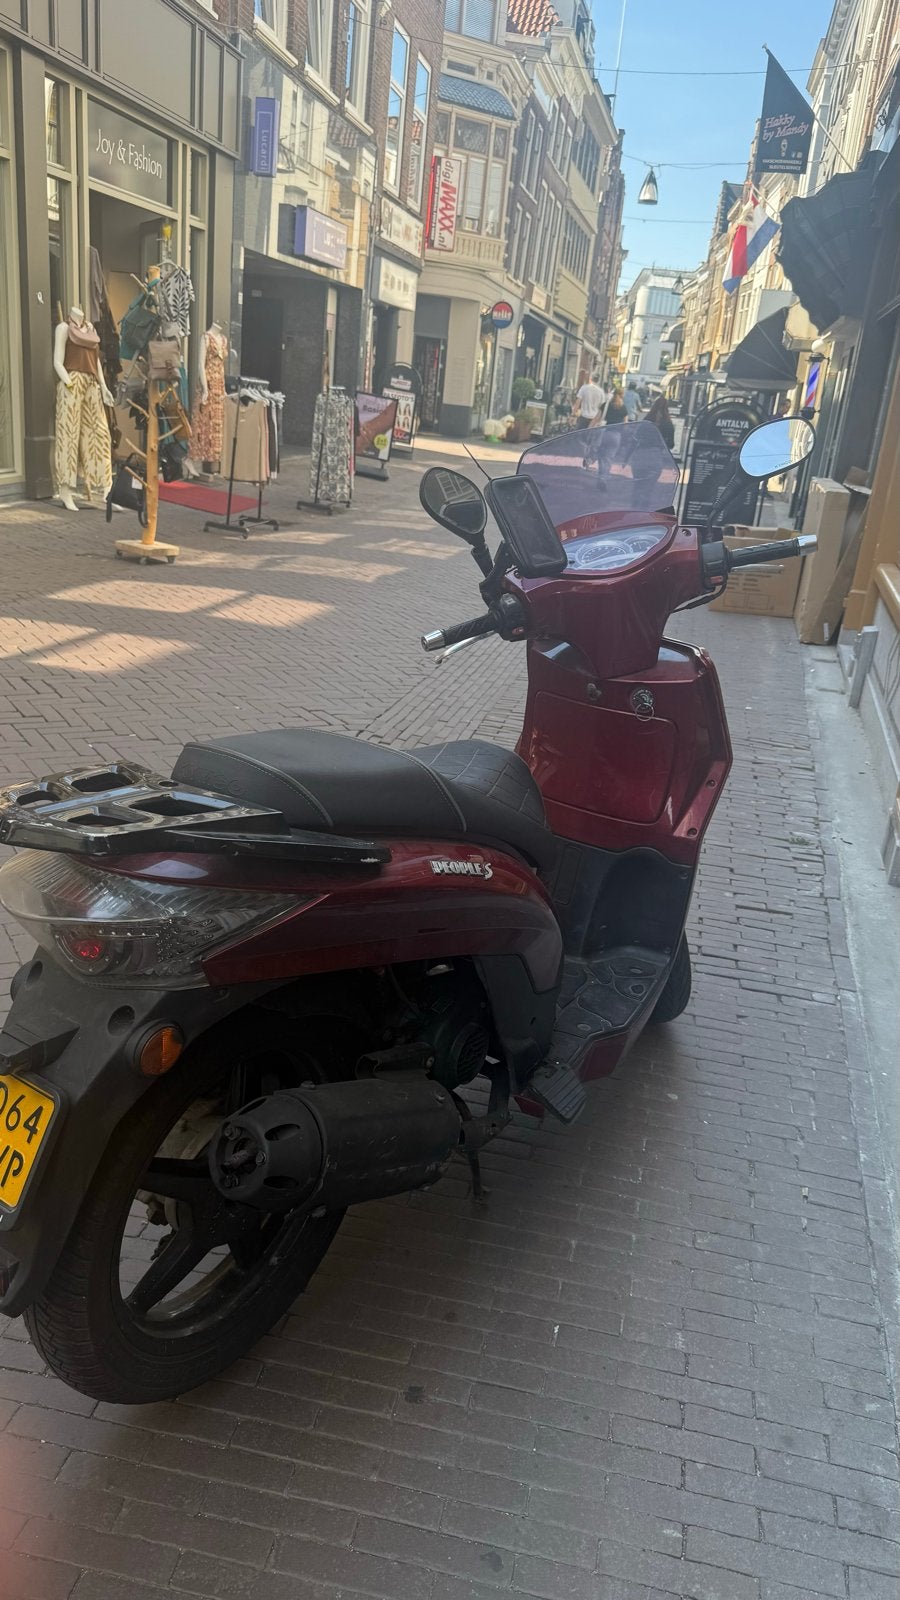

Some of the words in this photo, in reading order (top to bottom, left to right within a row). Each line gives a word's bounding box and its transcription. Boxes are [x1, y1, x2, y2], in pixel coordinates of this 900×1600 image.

[762, 129, 775, 143] by
[775, 121, 809, 138] Mandy
[96, 128, 115, 165] Joy
[117, 139, 126, 164] &
[128, 143, 163, 179] Fashion
[260, 129, 269, 171] Lucardi
[716, 418, 749, 429] ANTALYA
